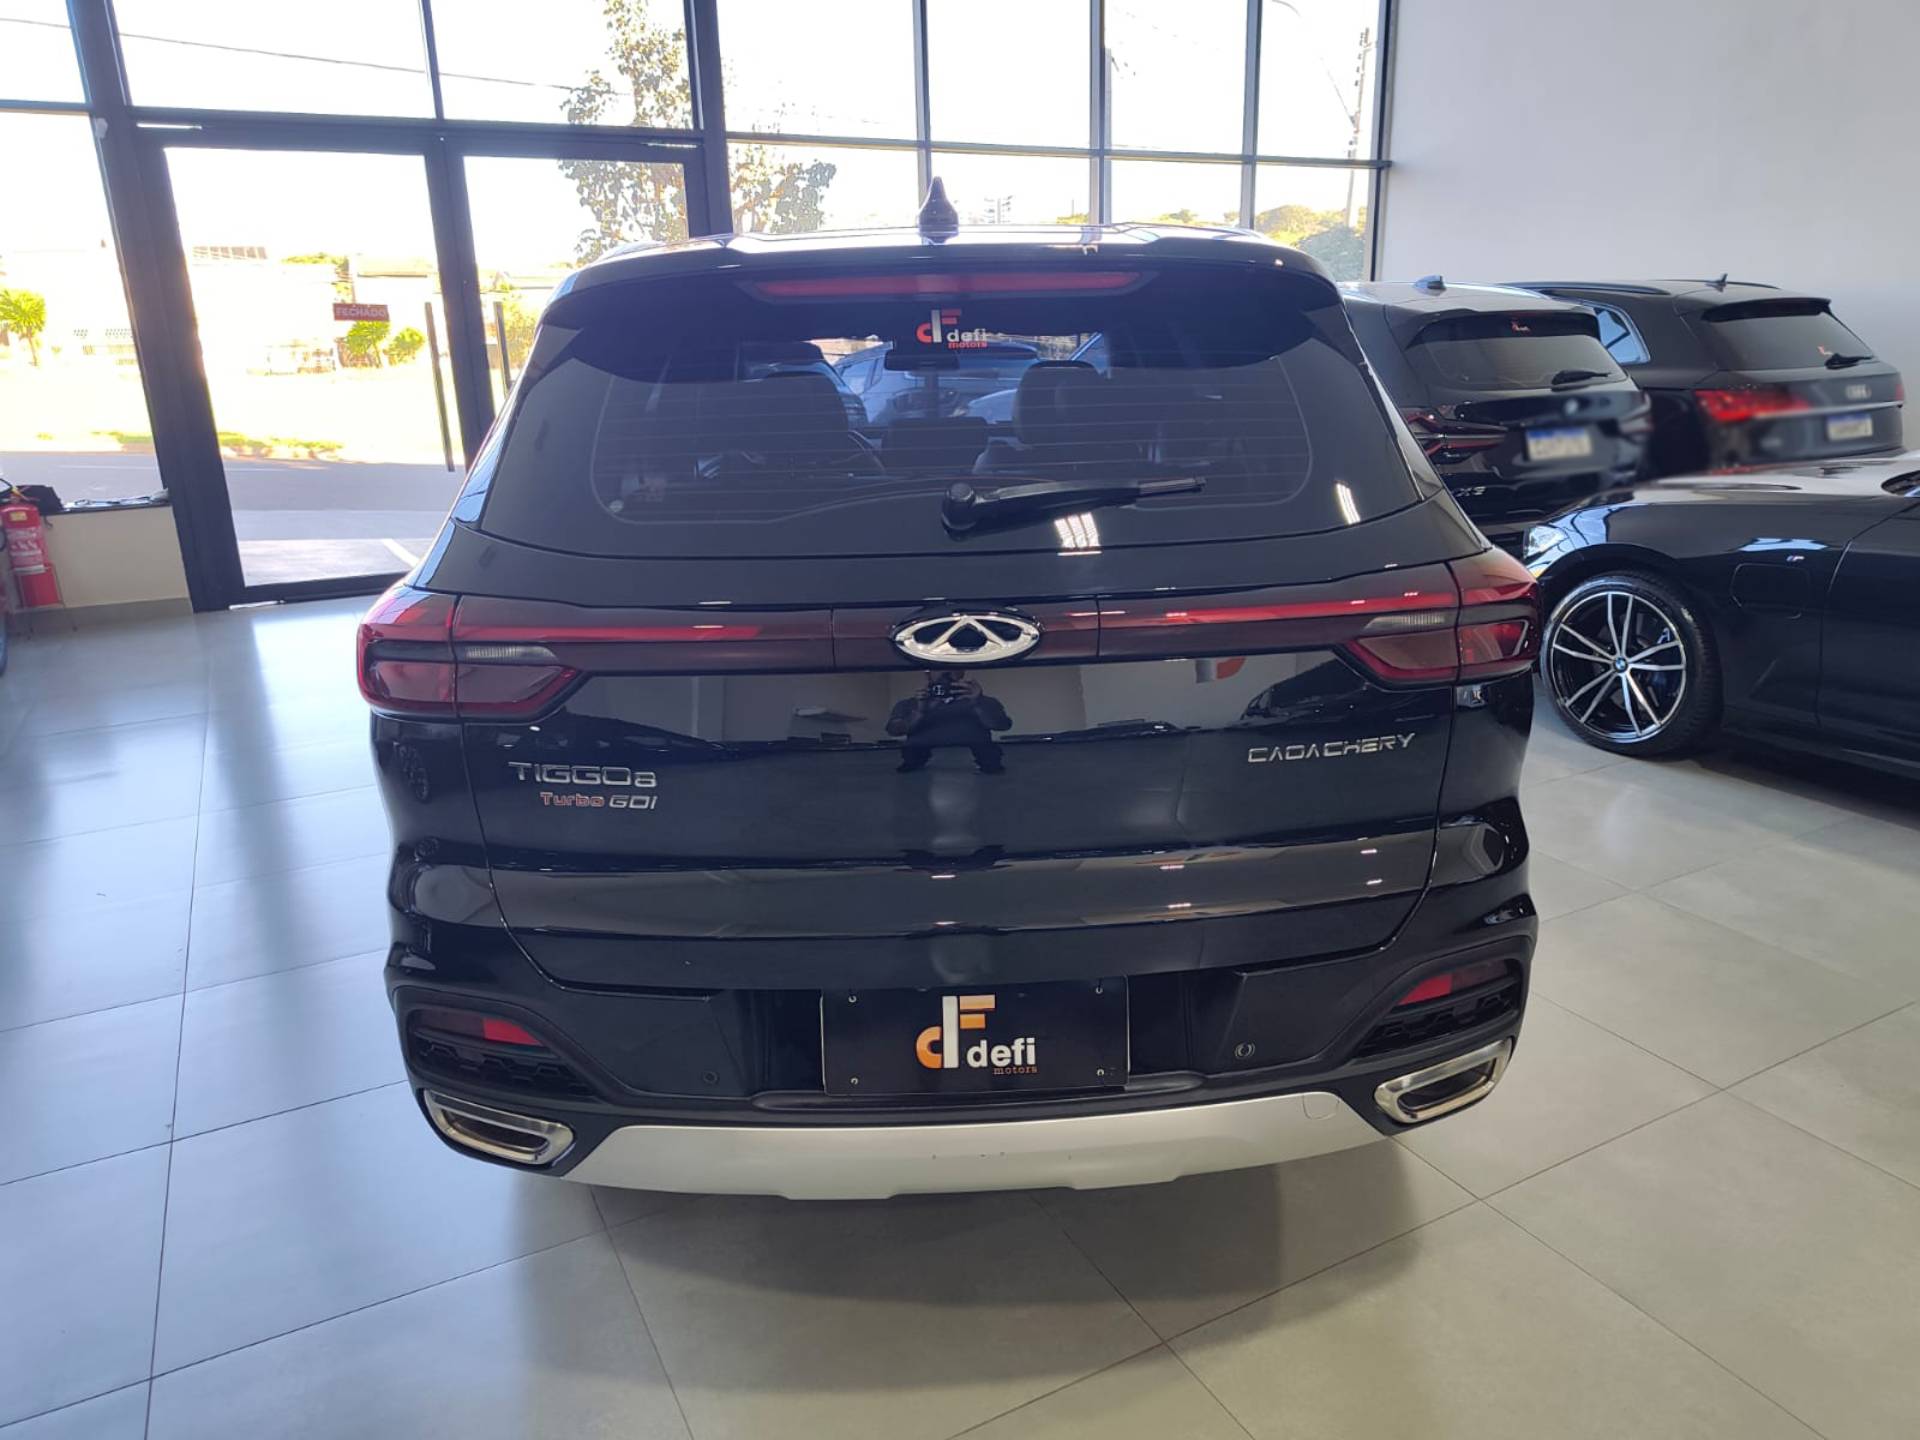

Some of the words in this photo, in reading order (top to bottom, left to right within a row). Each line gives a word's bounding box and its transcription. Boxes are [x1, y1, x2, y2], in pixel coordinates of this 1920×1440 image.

[946, 328, 987, 343] defi
[948, 341, 988, 349] motors
[540, 791, 605, 808] Turbo
[966, 1037, 1036, 1068] defi
[993, 1066, 1038, 1075] motors
